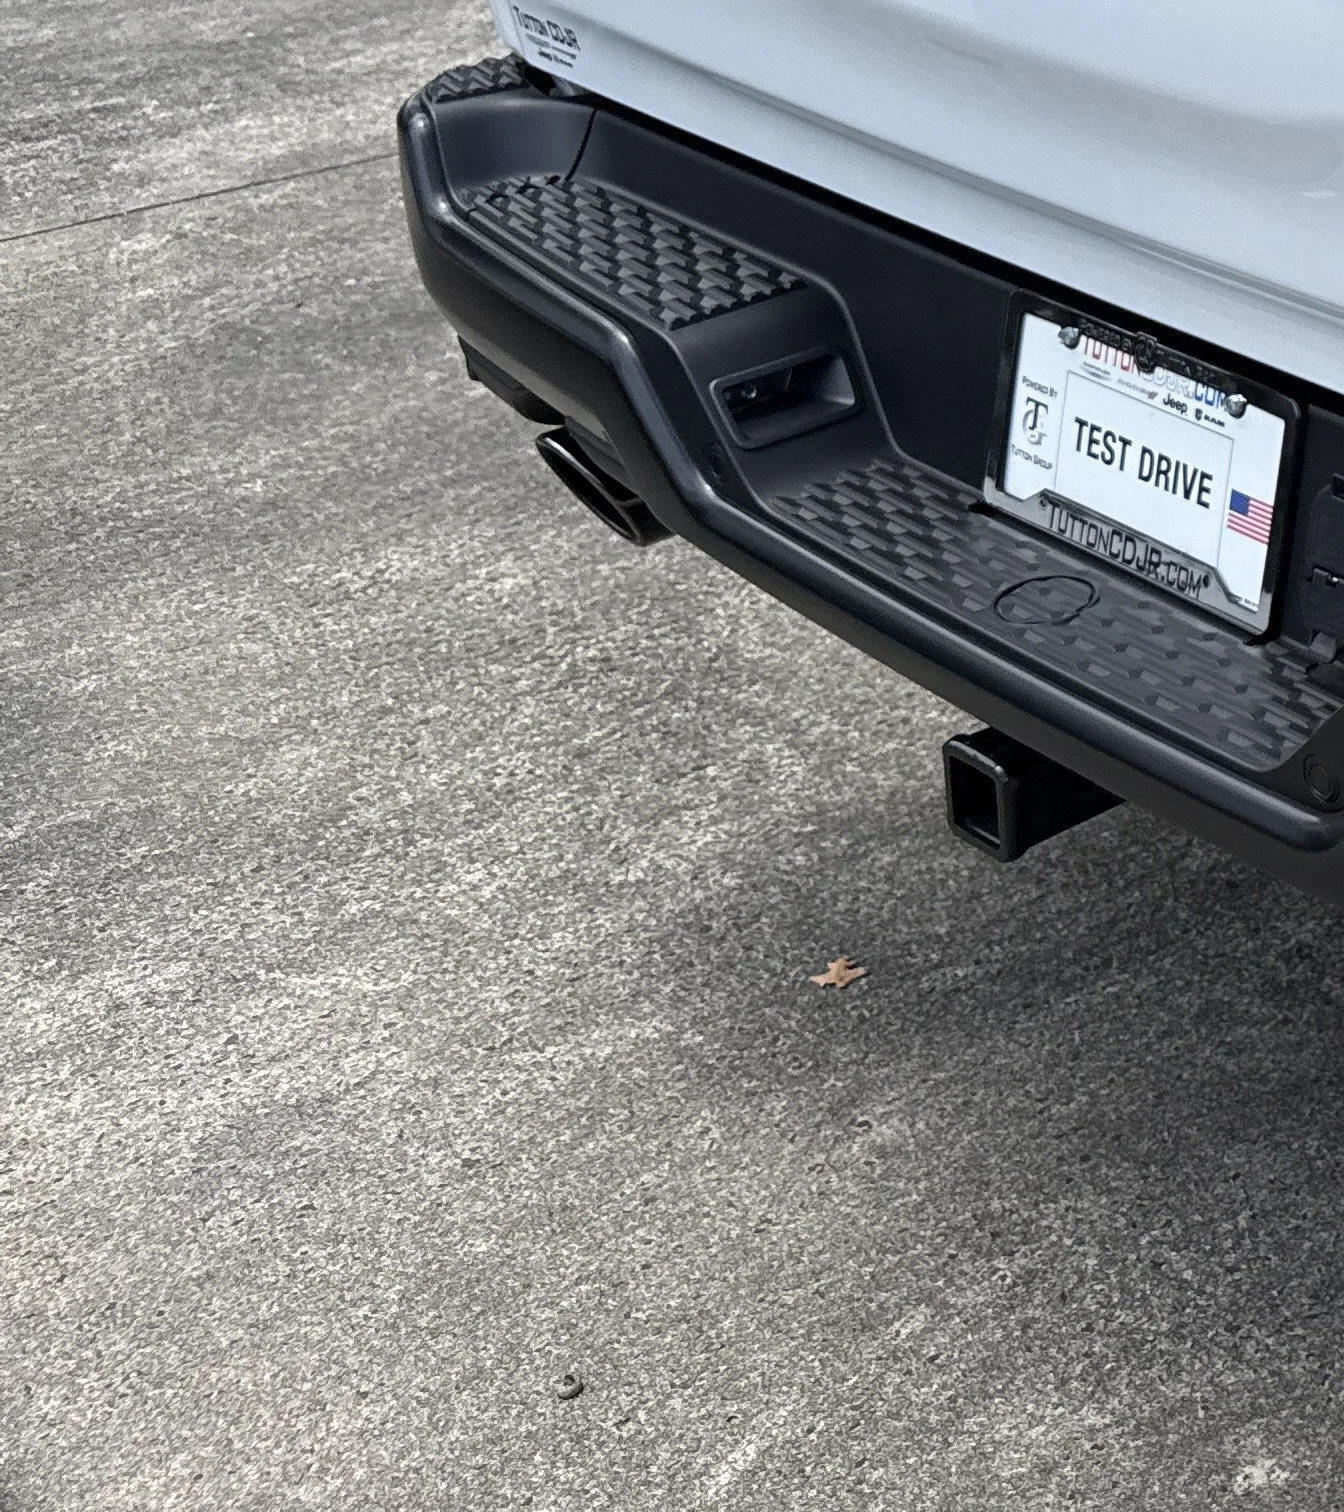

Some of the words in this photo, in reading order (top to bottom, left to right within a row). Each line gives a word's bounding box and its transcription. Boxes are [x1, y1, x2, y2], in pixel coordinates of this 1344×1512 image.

[1162, 392, 1189, 415] Jeep
[1074, 416, 1133, 472] TEST
[1138, 447, 1214, 509] DRIVE
[1049, 499, 1203, 600] TUTTONCDJR.COM
